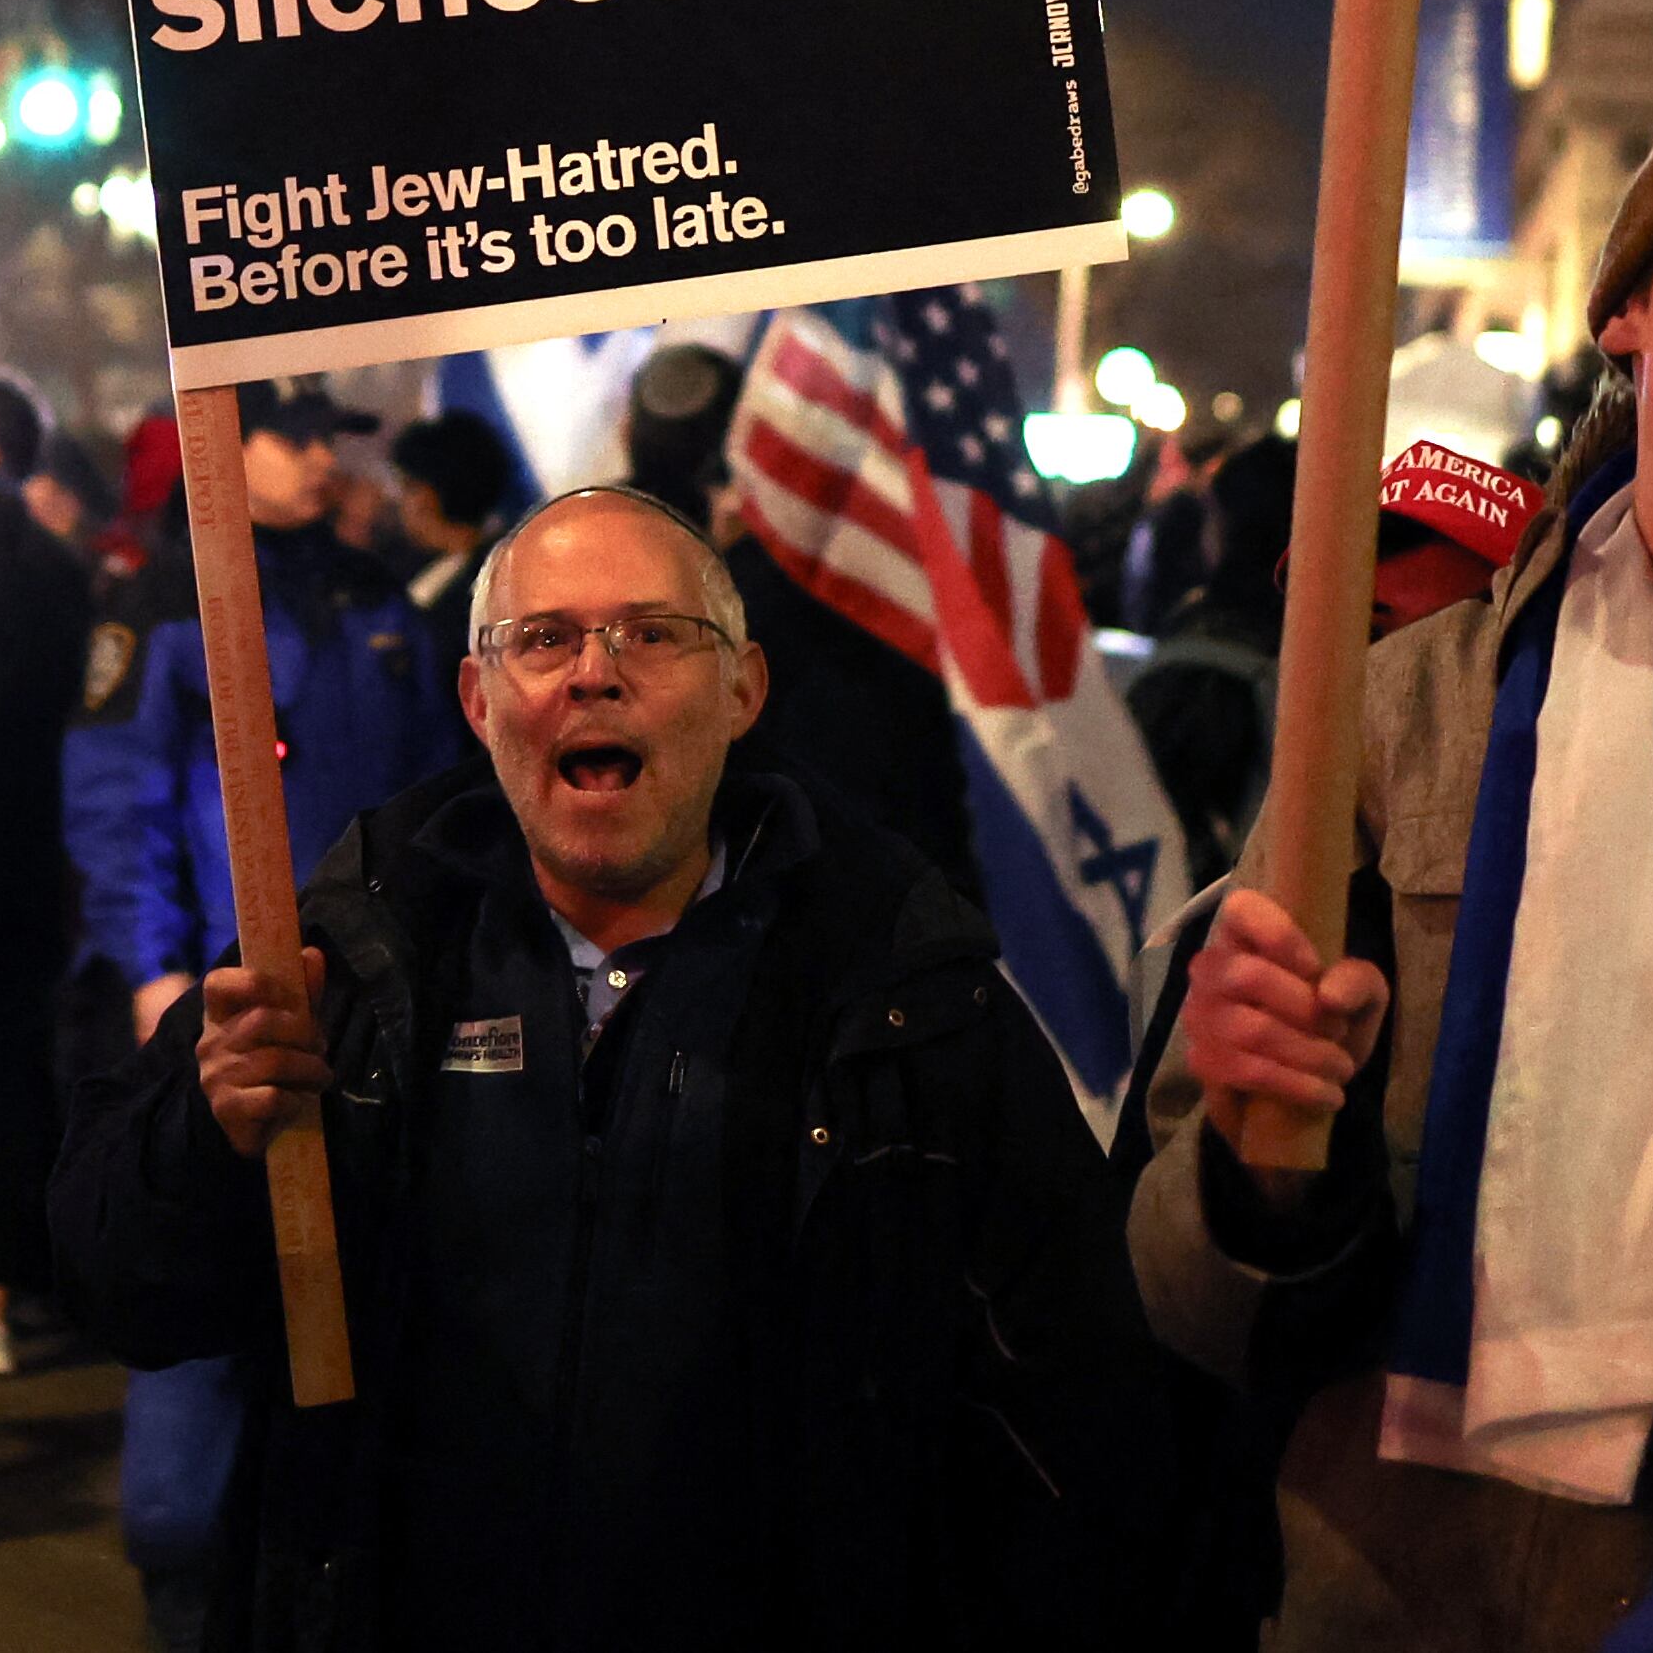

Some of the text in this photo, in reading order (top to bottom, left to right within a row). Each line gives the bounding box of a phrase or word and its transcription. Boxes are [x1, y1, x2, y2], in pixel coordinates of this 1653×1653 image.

[180, 122, 738, 253] Fight Jew-Hatred.
[1065, 79, 1092, 195] @gabedraws
[189, 189, 787, 313] Before it's too late.
[1395, 445, 1527, 510] AMERICA
[1413, 479, 1509, 528] AGAIN
